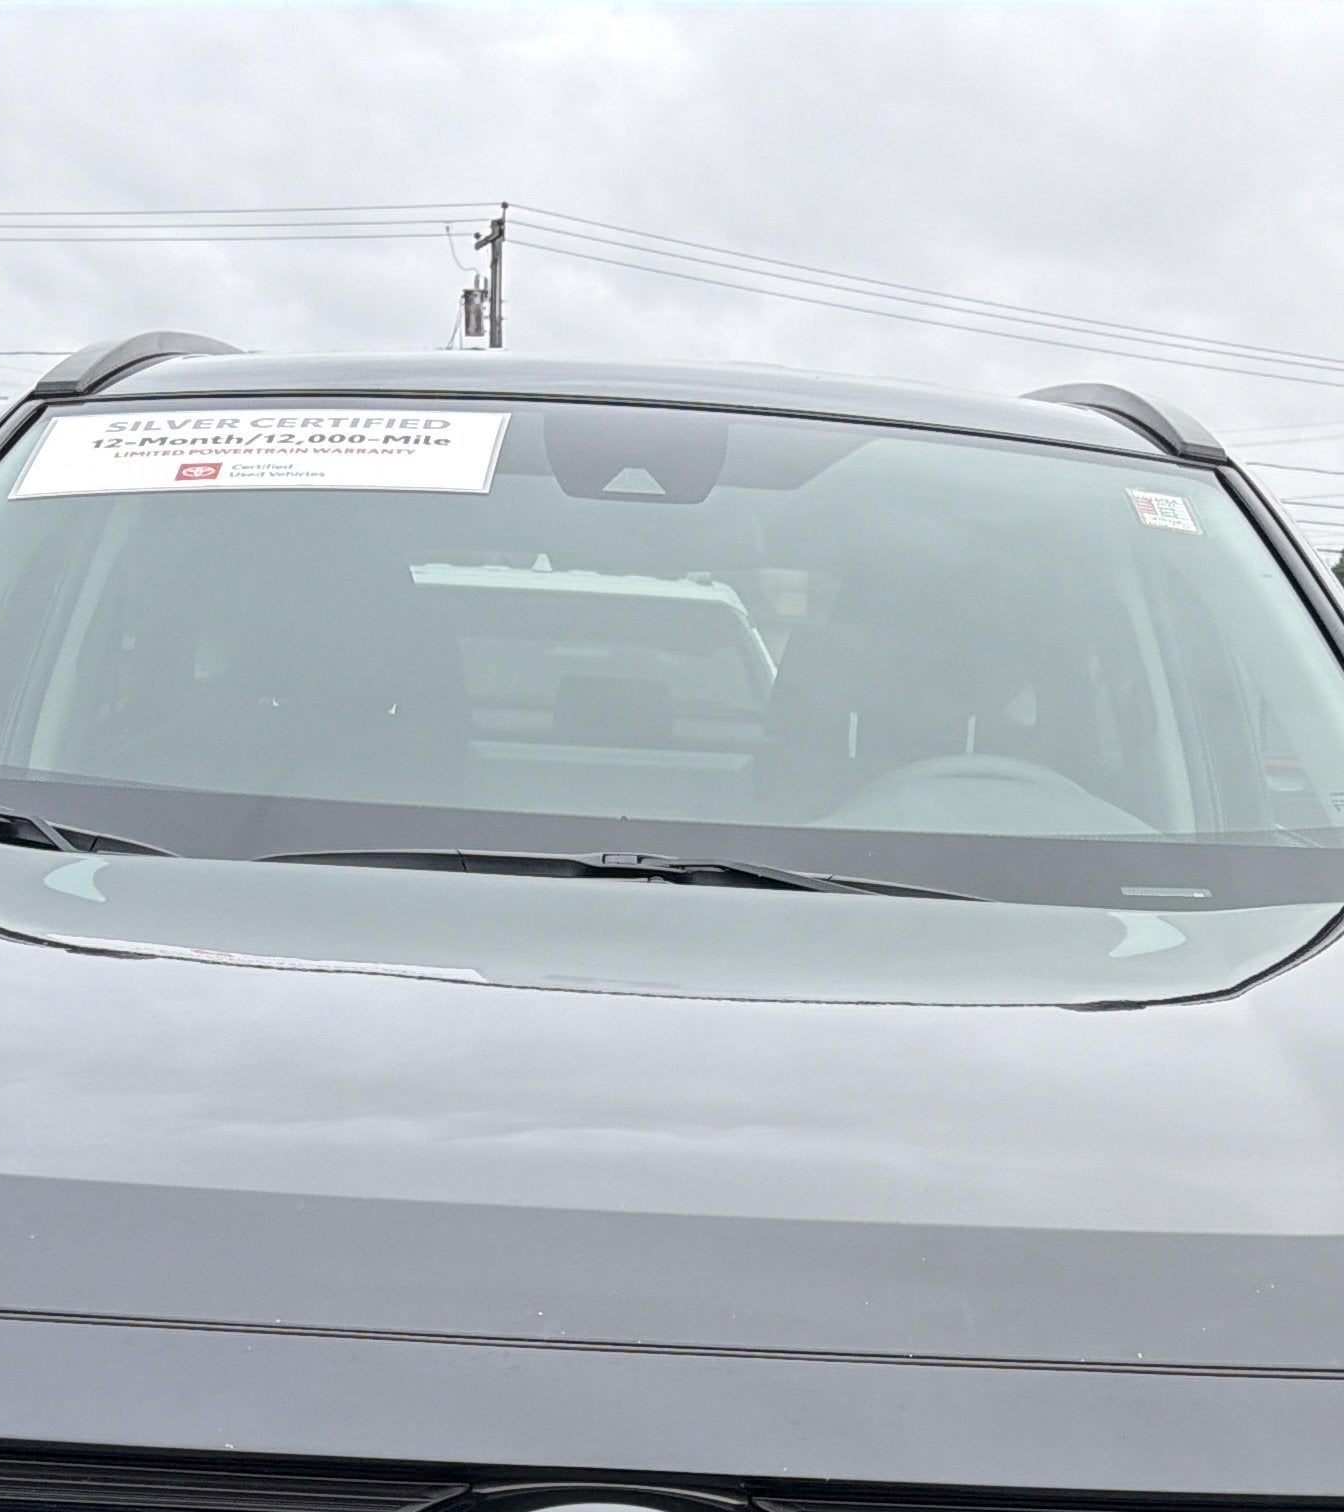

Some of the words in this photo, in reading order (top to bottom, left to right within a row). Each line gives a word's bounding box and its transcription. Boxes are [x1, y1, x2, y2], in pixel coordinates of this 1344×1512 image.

[105, 418, 241, 433] SILVER
[250, 417, 452, 430] CERTIFIED
[92, 433, 452, 449] 12-Month/12,000-Mile
[113, 449, 185, 459] LIMITED
[188, 447, 309, 456] POWERTRAIN
[312, 447, 417, 456] WARRANTY
